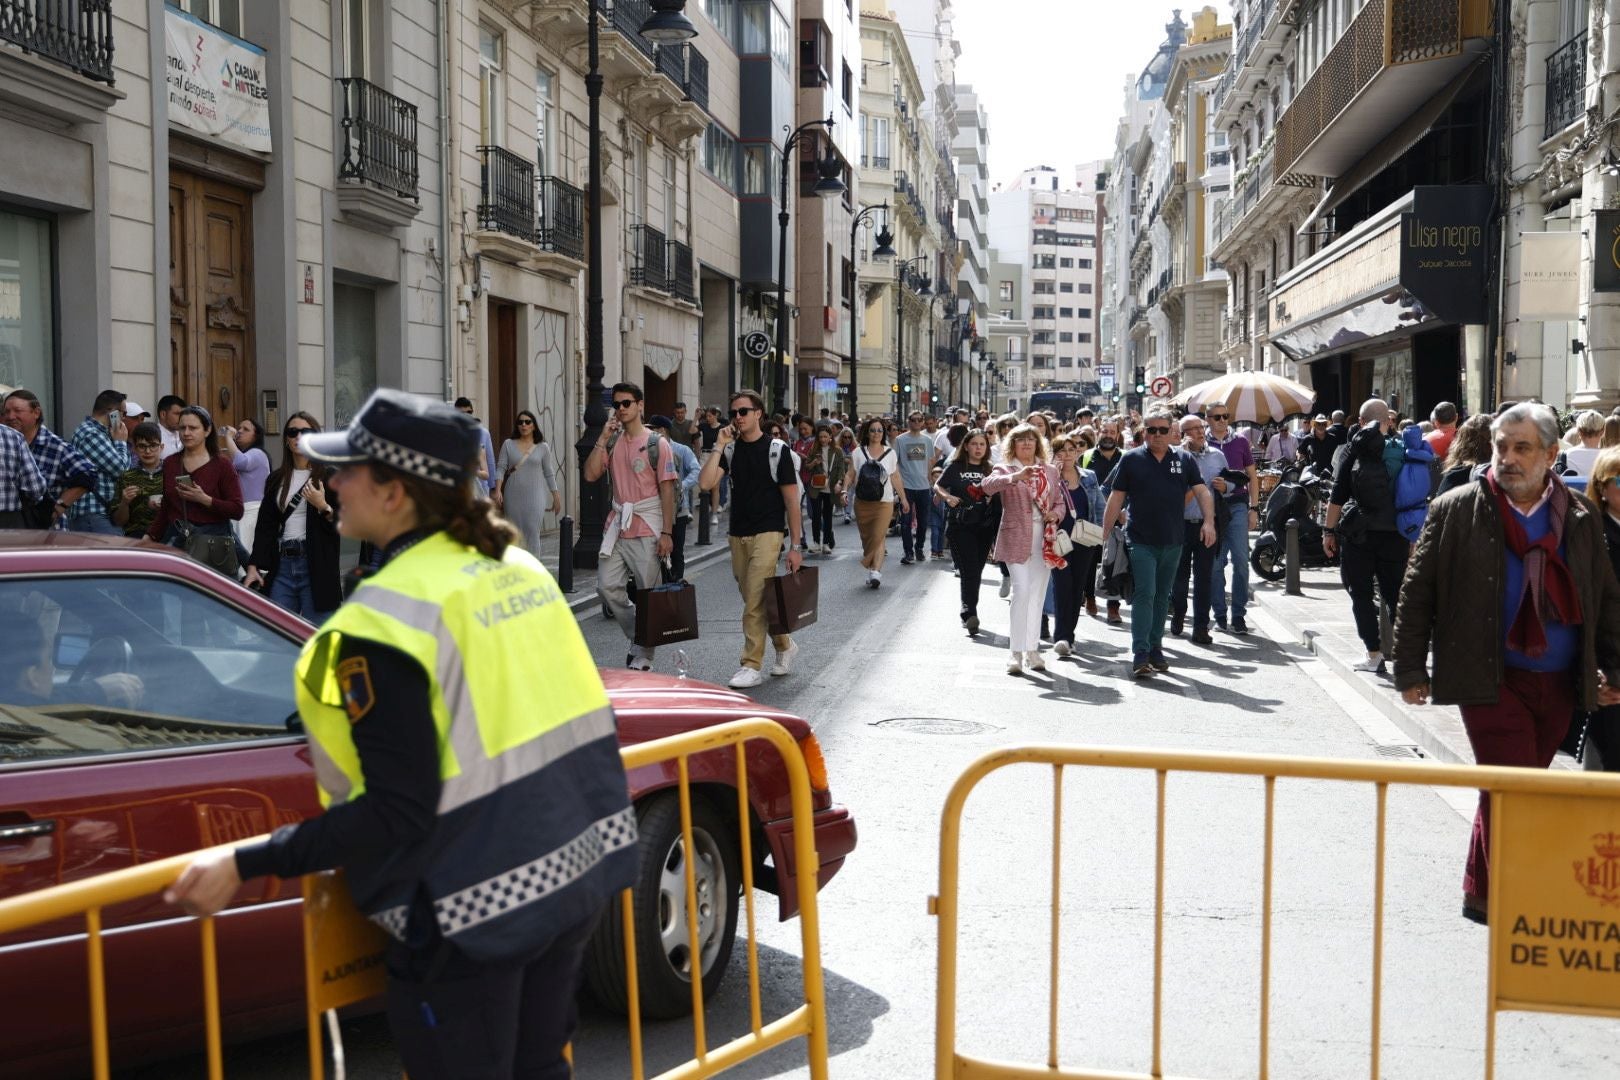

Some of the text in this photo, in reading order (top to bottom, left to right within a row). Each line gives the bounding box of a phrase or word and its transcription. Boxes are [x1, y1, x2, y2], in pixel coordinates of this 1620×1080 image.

[234, 77, 268, 100] HOTEES
[1409, 218, 1480, 255] Llisa negra
[1512, 914, 1620, 943] AJUNTA
[321, 953, 385, 984] AJUNTA
[1511, 943, 1548, 967] DE
